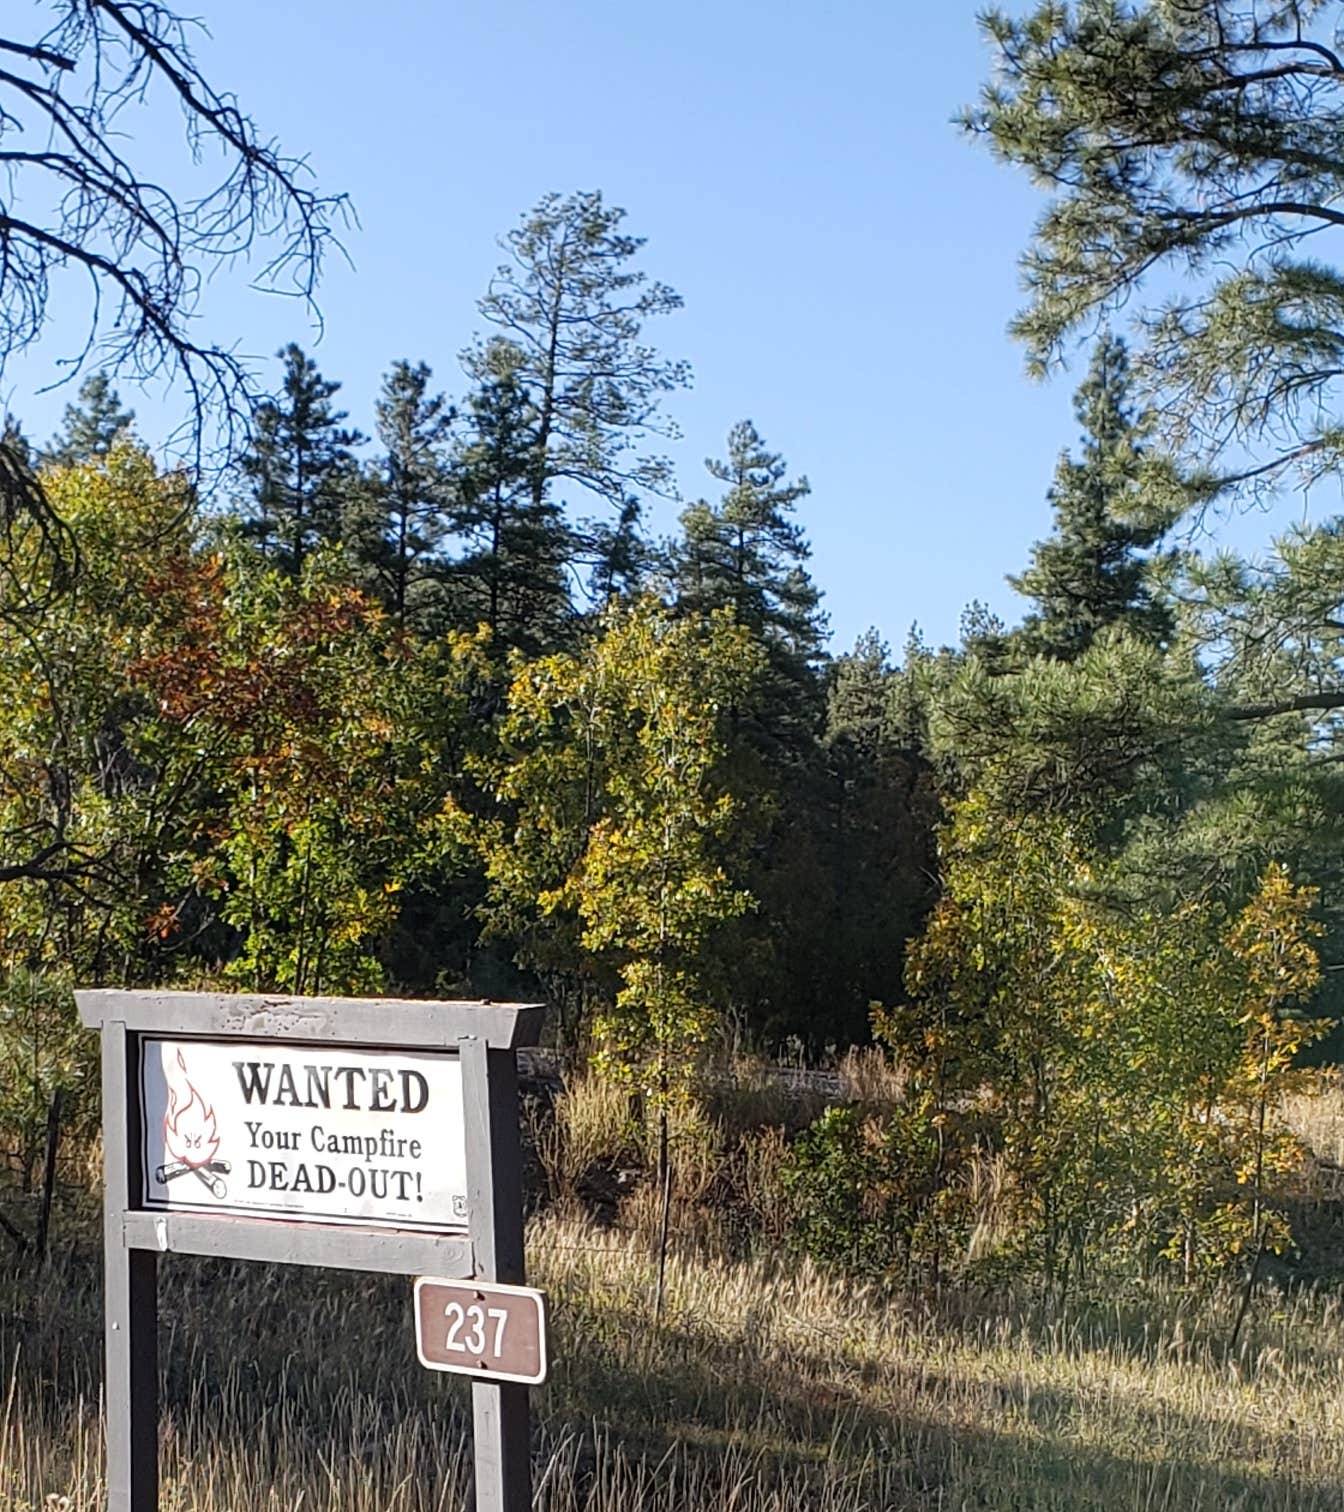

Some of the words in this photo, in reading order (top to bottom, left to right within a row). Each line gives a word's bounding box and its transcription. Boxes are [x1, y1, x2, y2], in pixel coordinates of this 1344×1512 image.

[233, 1061, 429, 1113] WANTED
[244, 1121, 301, 1151] Your
[310, 1125, 422, 1162] Campfire
[247, 1160, 424, 1202] DEAD-OUT!
[444, 1302, 508, 1357] 237
